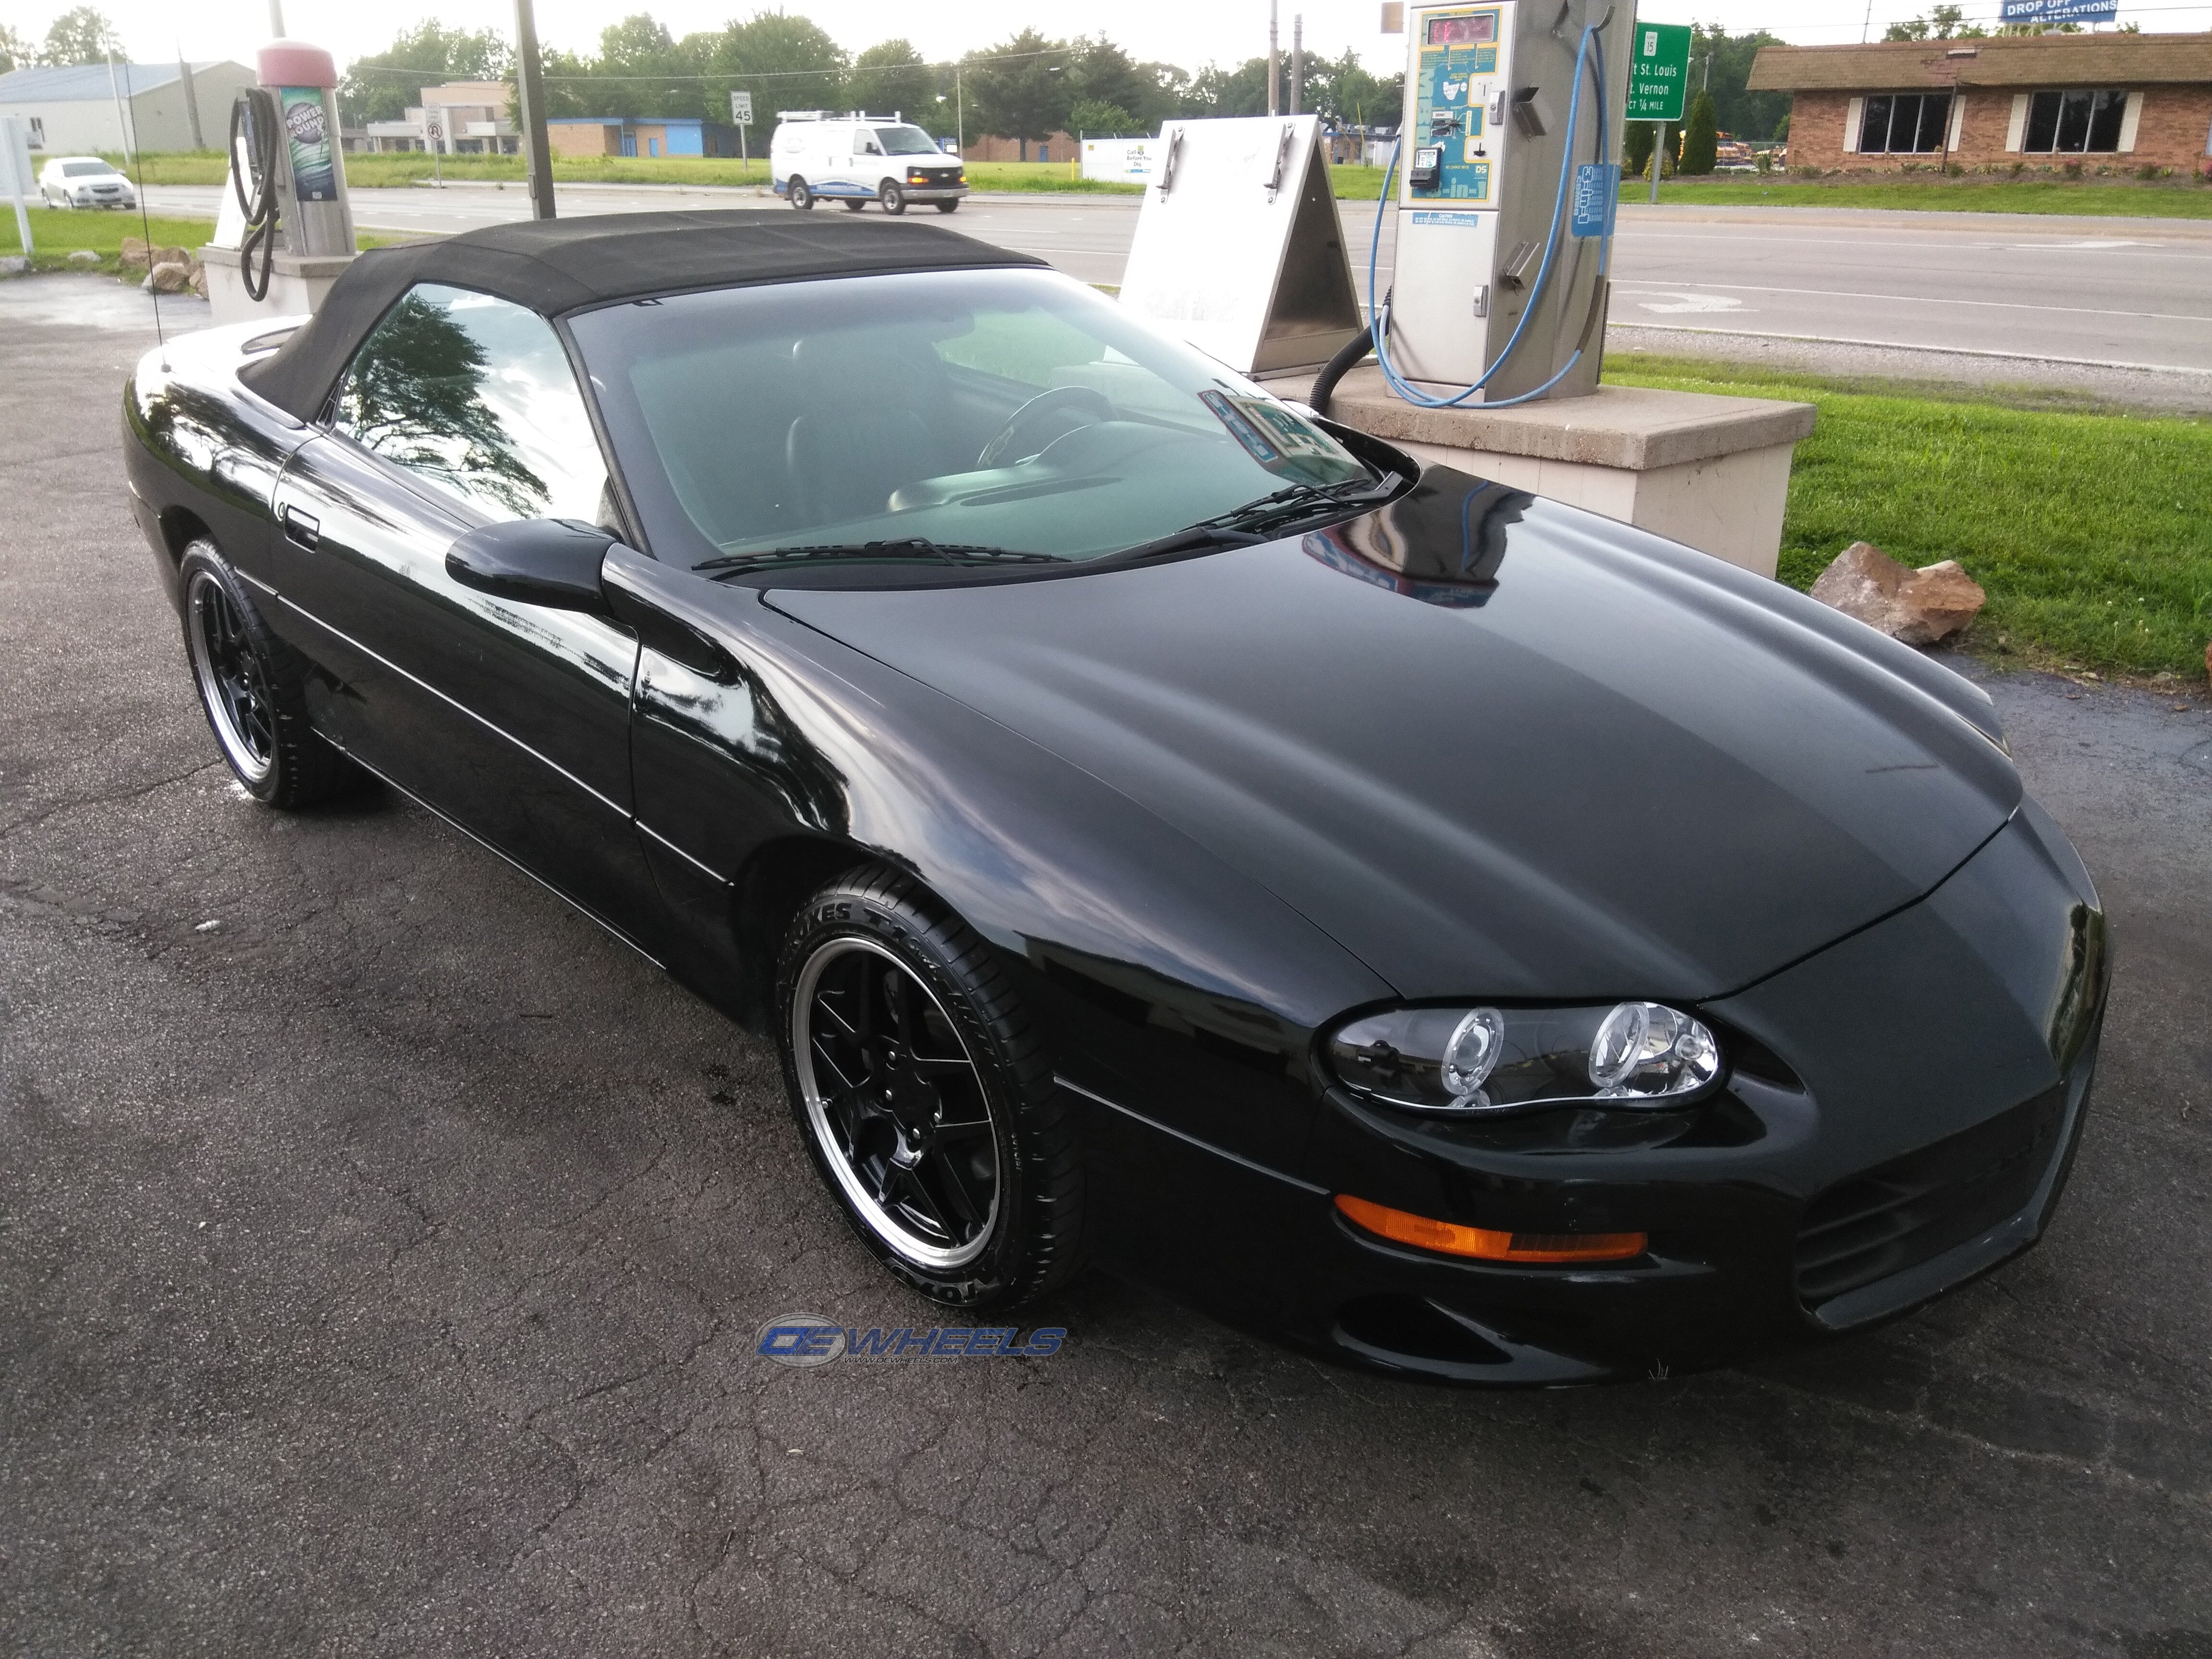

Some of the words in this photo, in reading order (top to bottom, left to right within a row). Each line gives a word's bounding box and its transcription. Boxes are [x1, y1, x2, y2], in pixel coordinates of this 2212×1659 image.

[2007, 0, 2043, 15] DROP
[2031, 0, 2117, 23] ALTERATIONS
[1647, 41, 1653, 52] 15
[1640, 63, 1651, 75] St.
[1654, 64, 1677, 76] Louis
[1639, 83, 1669, 95] Vernon
[1628, 100, 1636, 109] CT
[1649, 101, 1663, 110] MILE
[286, 105, 324, 129] POWER
[736, 111, 750, 121] 45
